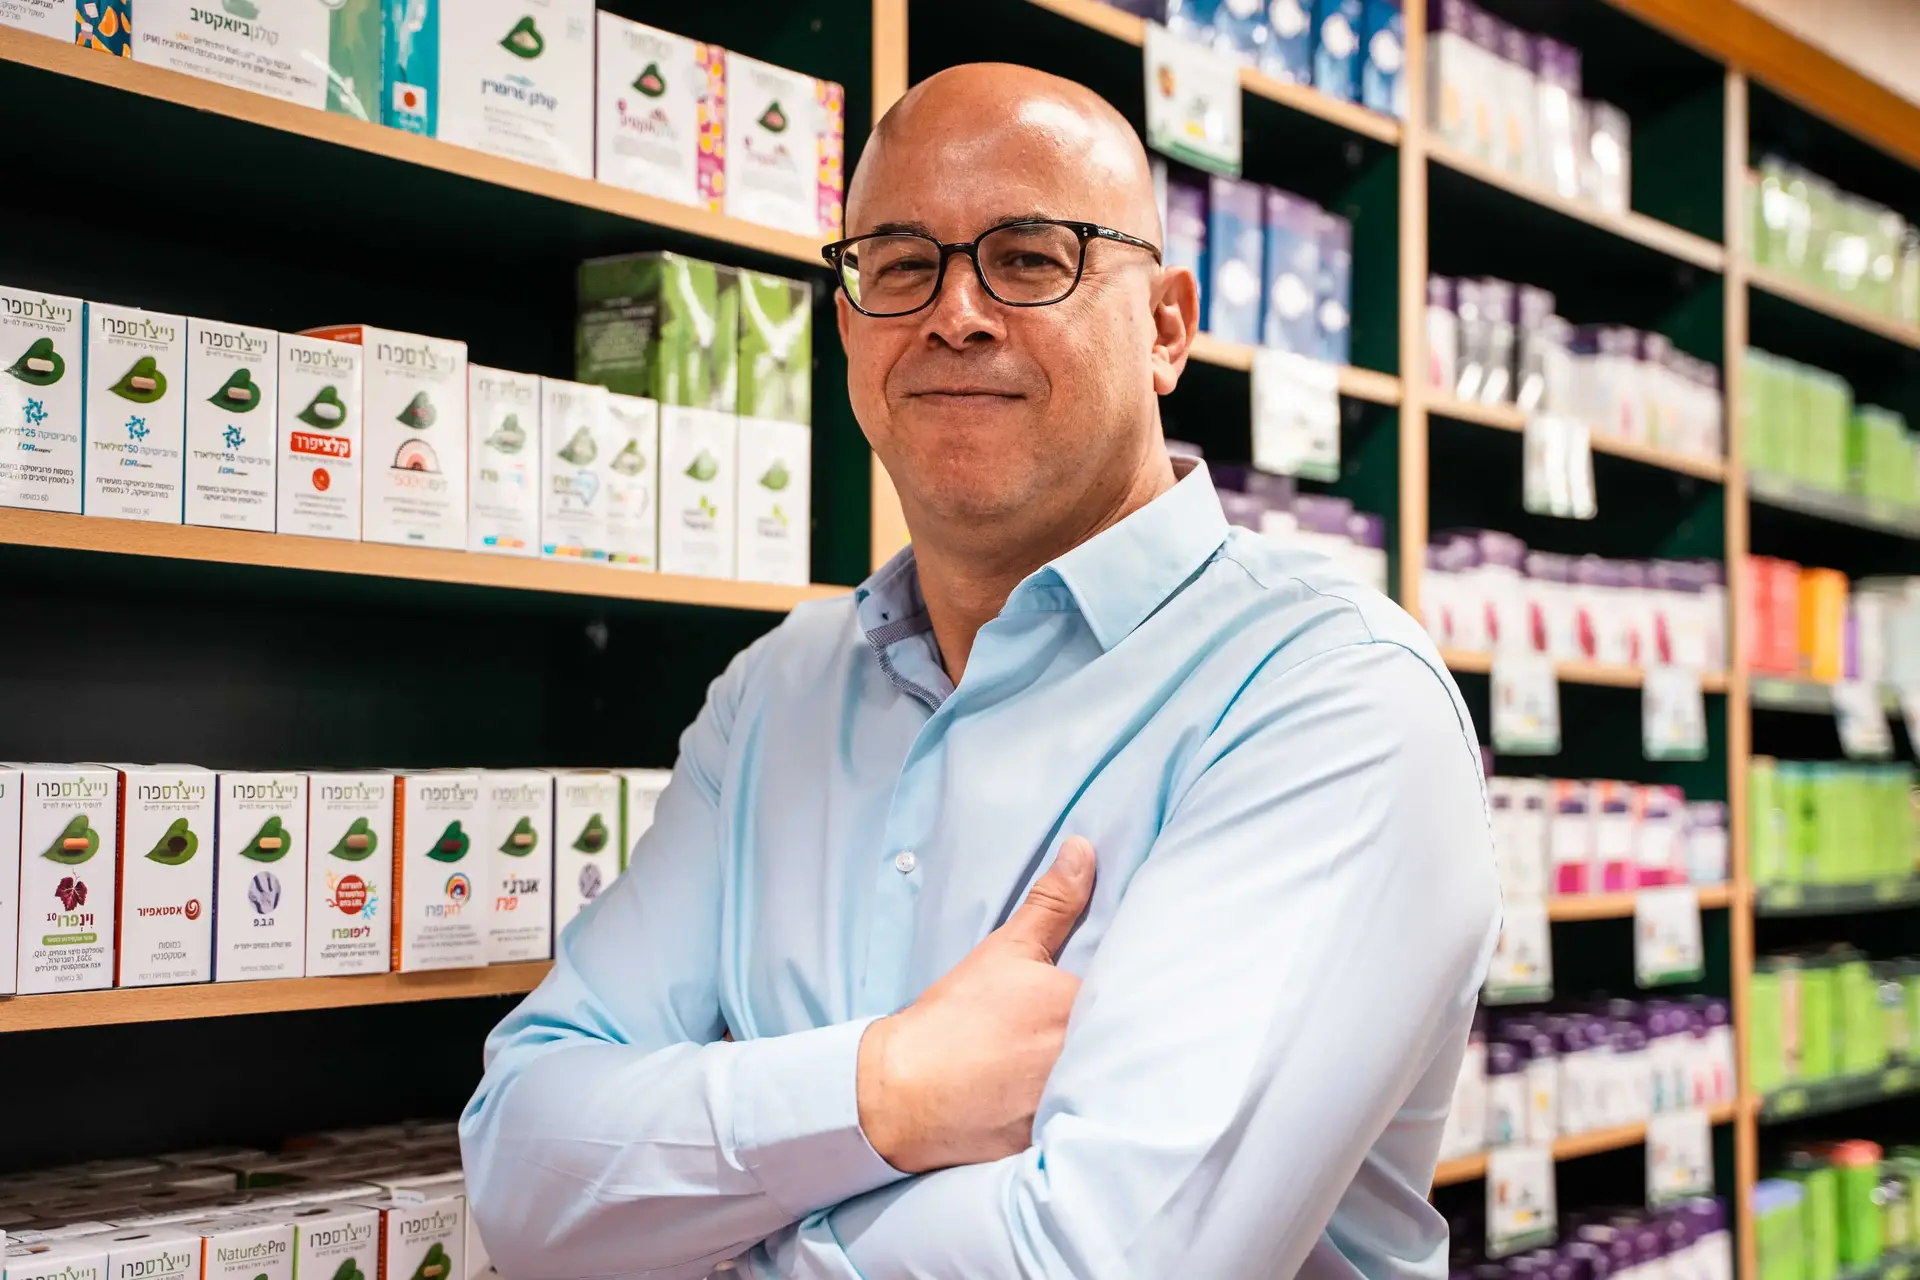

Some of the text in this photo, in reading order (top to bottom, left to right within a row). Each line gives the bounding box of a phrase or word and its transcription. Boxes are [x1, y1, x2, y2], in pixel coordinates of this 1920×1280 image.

[190, 7, 250, 36] ביואקטיב
[2, 298, 72, 322] נייצ'רספר
[22, 321, 44, 330] בריאות
[38, 430, 77, 442] פרוביוטיקה
[53, 467, 73, 476] כמוסות
[495, 896, 519, 912] פרו
[137, 906, 183, 917] אסטאפיור
[332, 926, 371, 939] ליפופרו
[237, 1262, 262, 1270] HEALTHY
